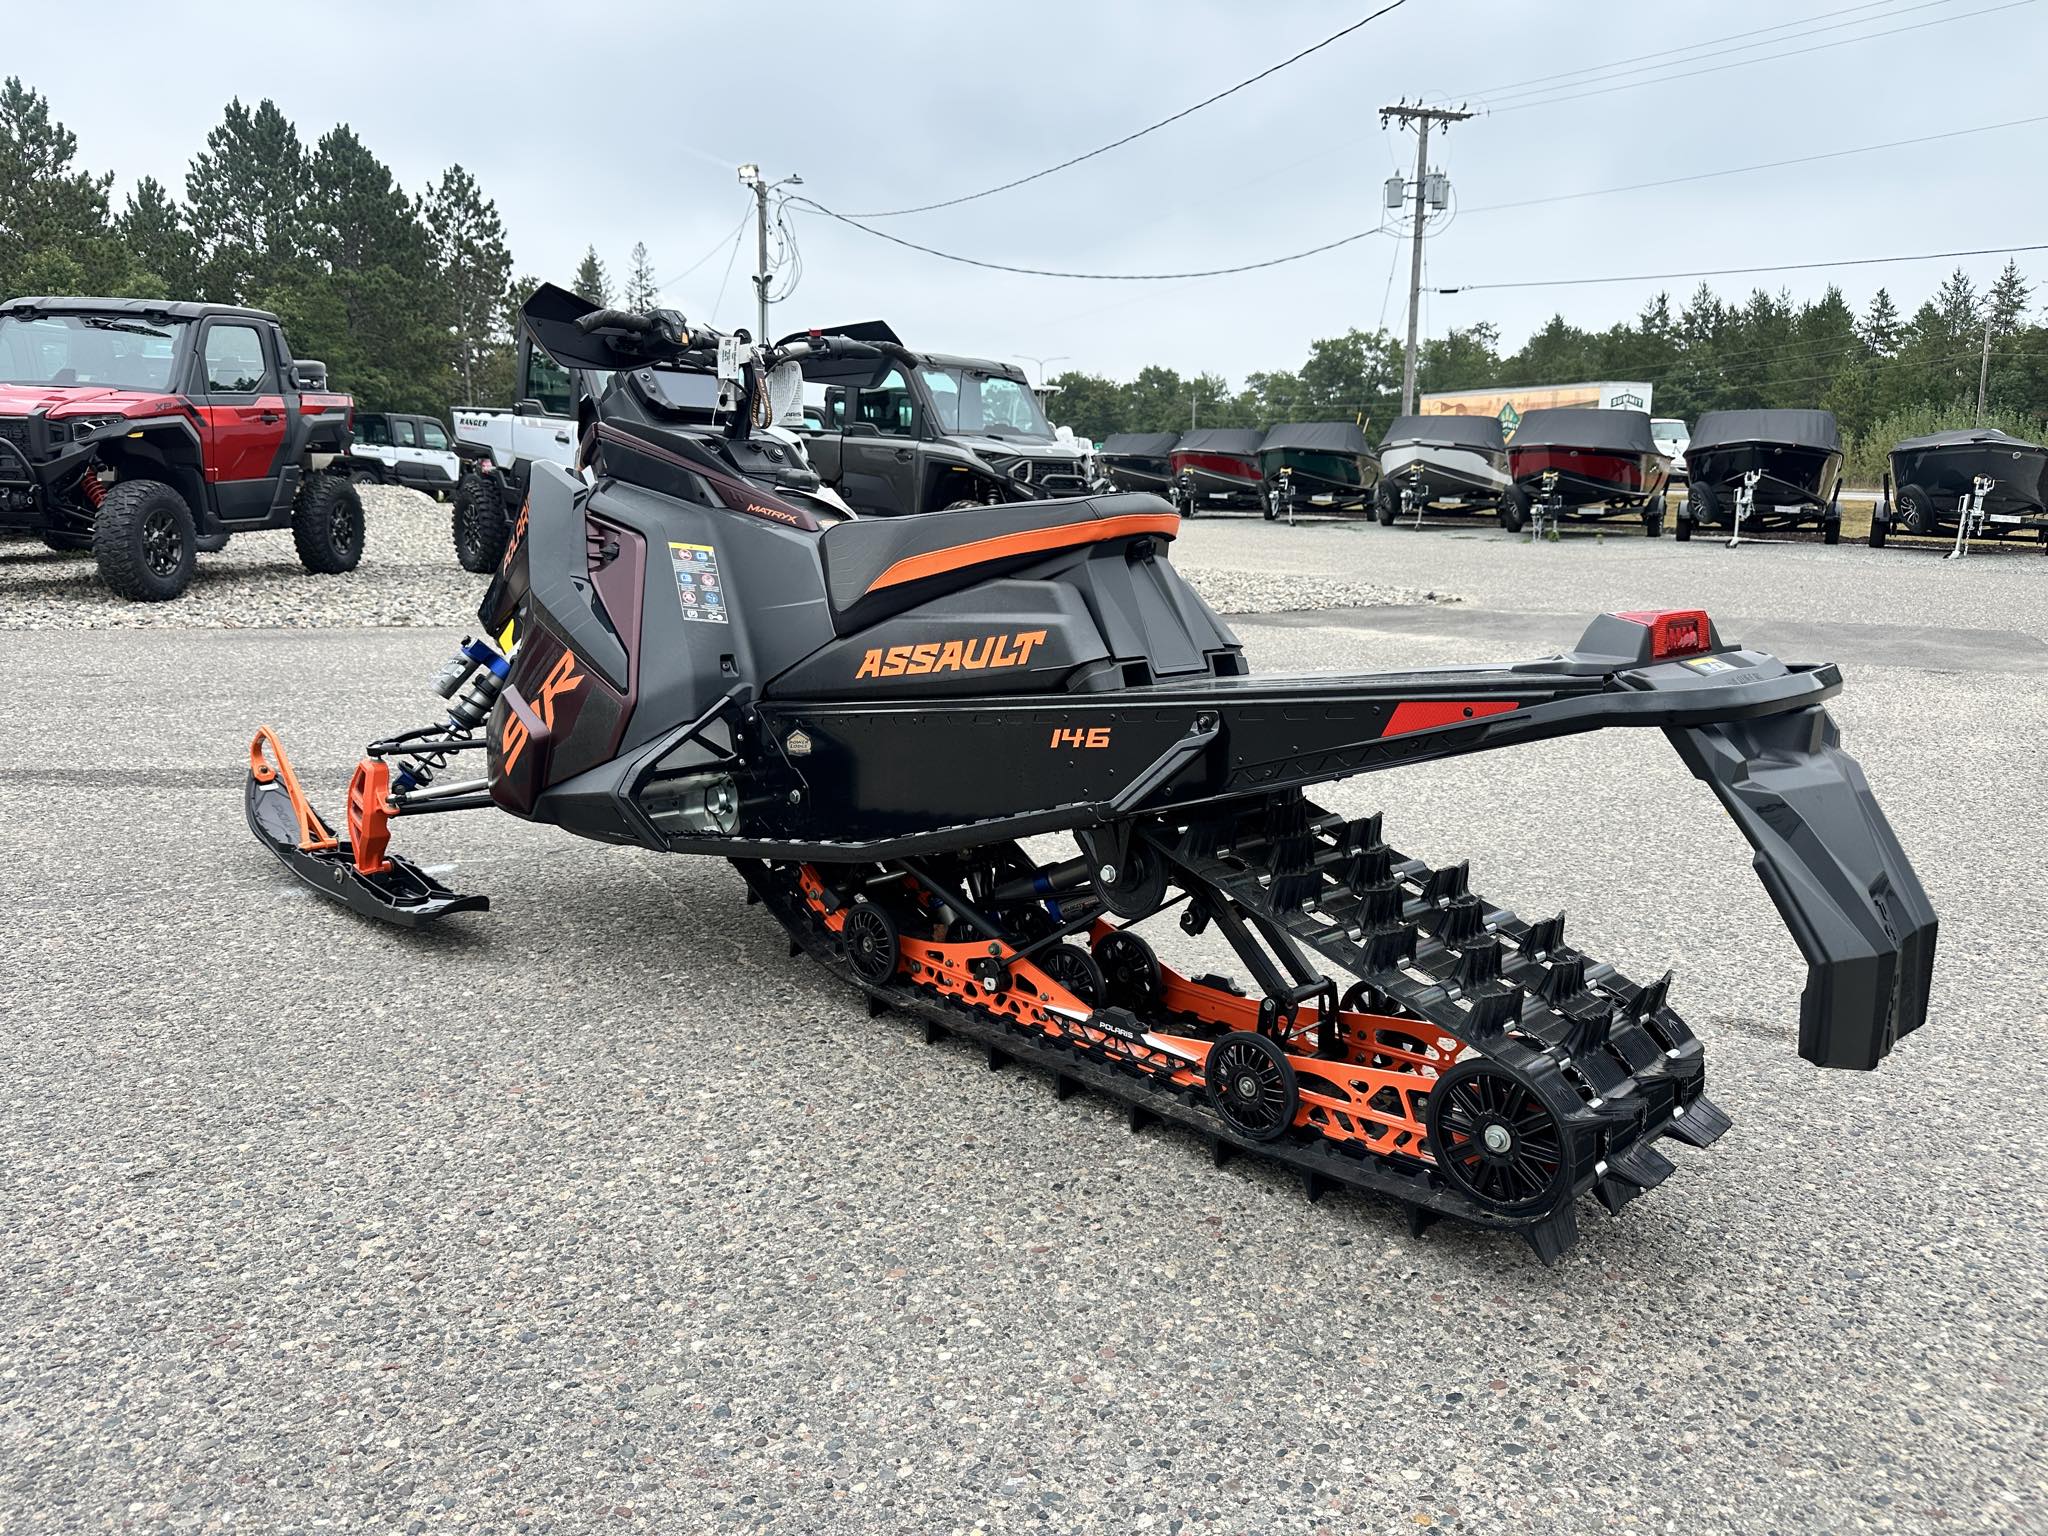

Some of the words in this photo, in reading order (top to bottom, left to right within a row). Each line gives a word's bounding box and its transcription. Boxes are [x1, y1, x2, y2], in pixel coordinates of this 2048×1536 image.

[1612, 394, 1643, 407] SUMMIT
[459, 418, 488, 428] RANGER
[747, 503, 797, 525] MATRYX
[855, 630, 1048, 679] ASSAULT
[1050, 728, 1111, 748] 146
[1099, 1021, 1134, 1039] POLARIS
